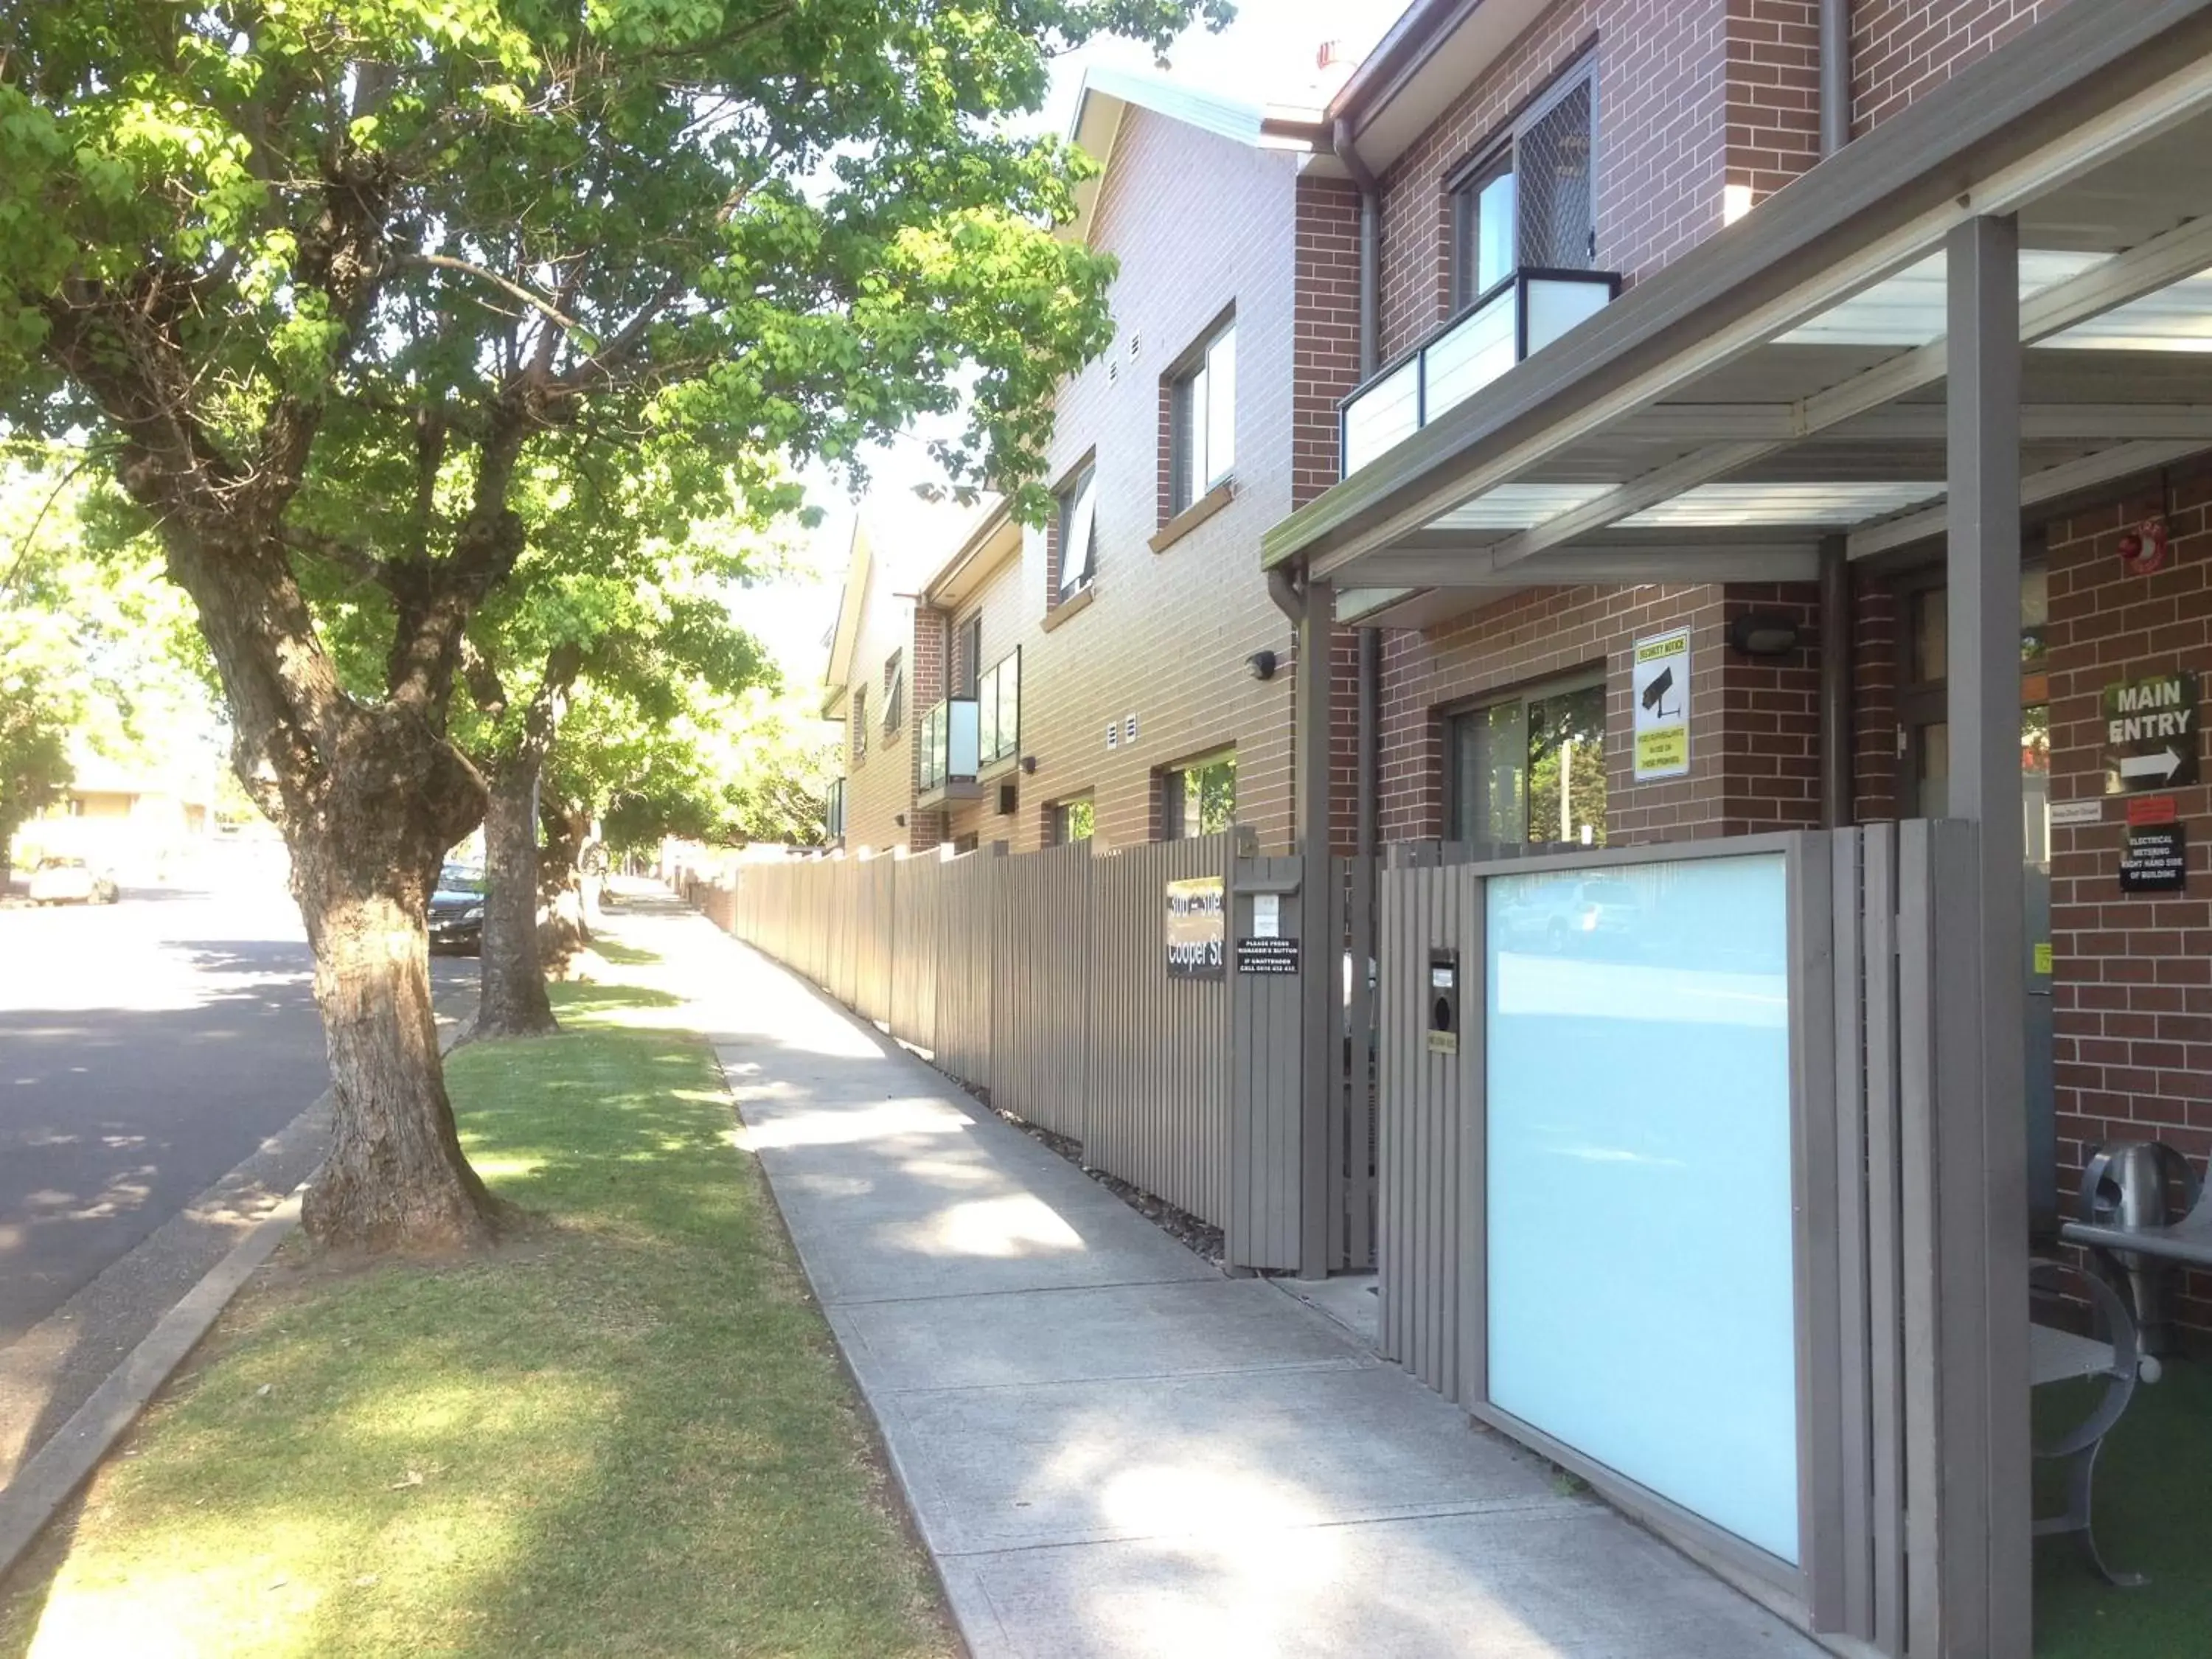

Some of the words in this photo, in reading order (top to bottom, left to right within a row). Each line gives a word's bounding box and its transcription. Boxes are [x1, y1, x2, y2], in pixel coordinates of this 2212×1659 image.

[1640, 644, 1664, 660] SECURITY
[1665, 637, 1685, 653] NOTICE
[2118, 680, 2180, 712] MAIN
[2109, 709, 2191, 743] ENTRY
[2129, 835, 2173, 846] ELECTRICAL
[2121, 860, 2143, 869] RIGHT
[2143, 858, 2166, 868] HAND
[2166, 857, 2183, 867] SIDE
[2130, 872, 2140, 880] OF
[2140, 869, 2177, 879] BUILDING
[1169, 934, 1207, 972] Cooper
[1210, 933, 1222, 966] St
